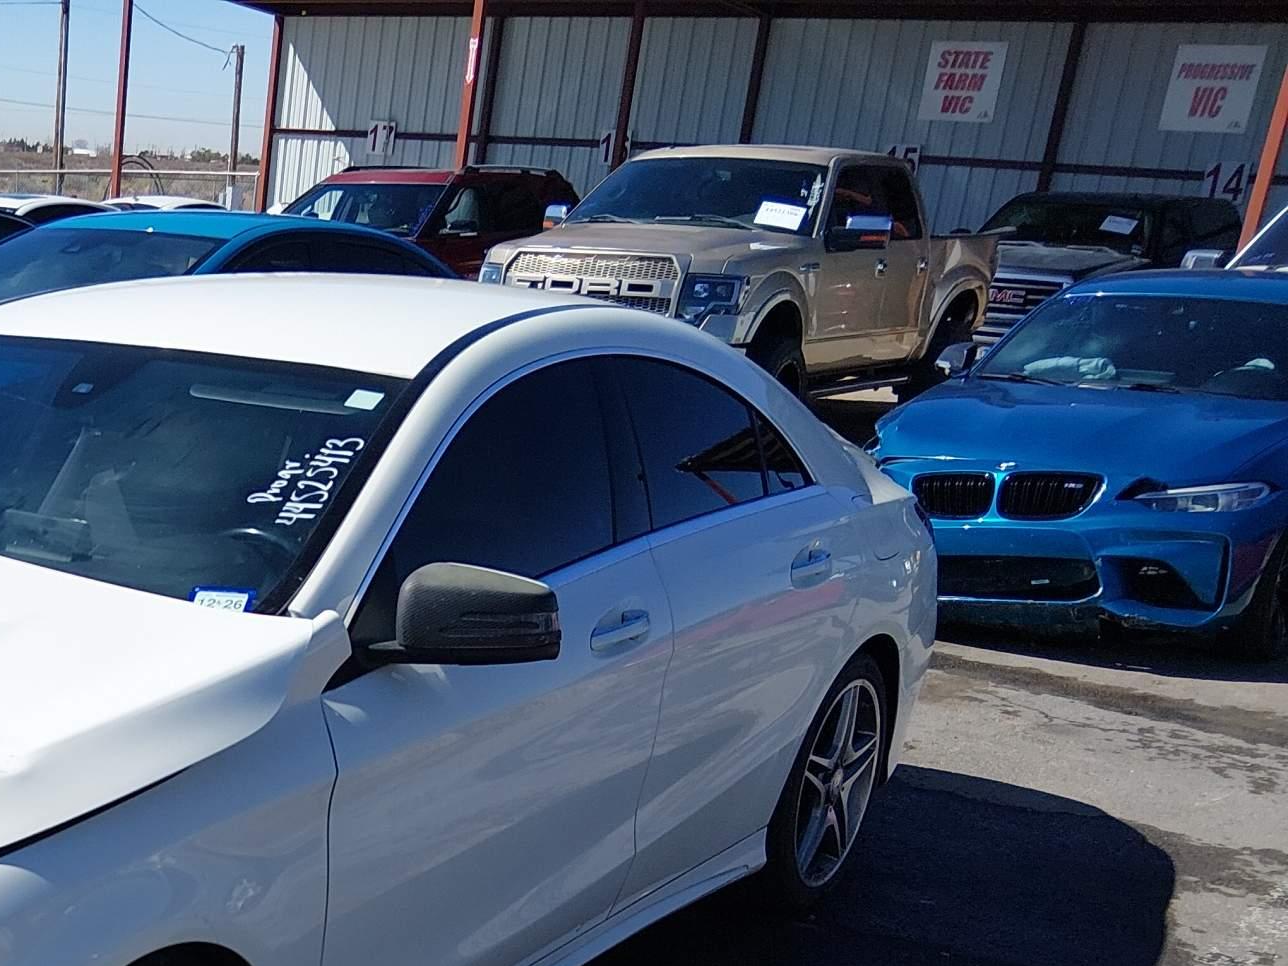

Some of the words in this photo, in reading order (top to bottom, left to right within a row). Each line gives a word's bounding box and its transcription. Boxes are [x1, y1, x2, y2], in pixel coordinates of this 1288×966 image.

[937, 50, 994, 70] STATE
[933, 72, 988, 92] FARM
[1177, 63, 1257, 81] PROGRESSIVE
[939, 95, 975, 114] VIC
[1187, 86, 1229, 118] VIC
[369, 124, 394, 153] 17
[1206, 162, 1246, 200] 14
[512, 272, 663, 298] FORD
[988, 288, 1026, 303] MC
[275, 437, 365, 526] 44525413
